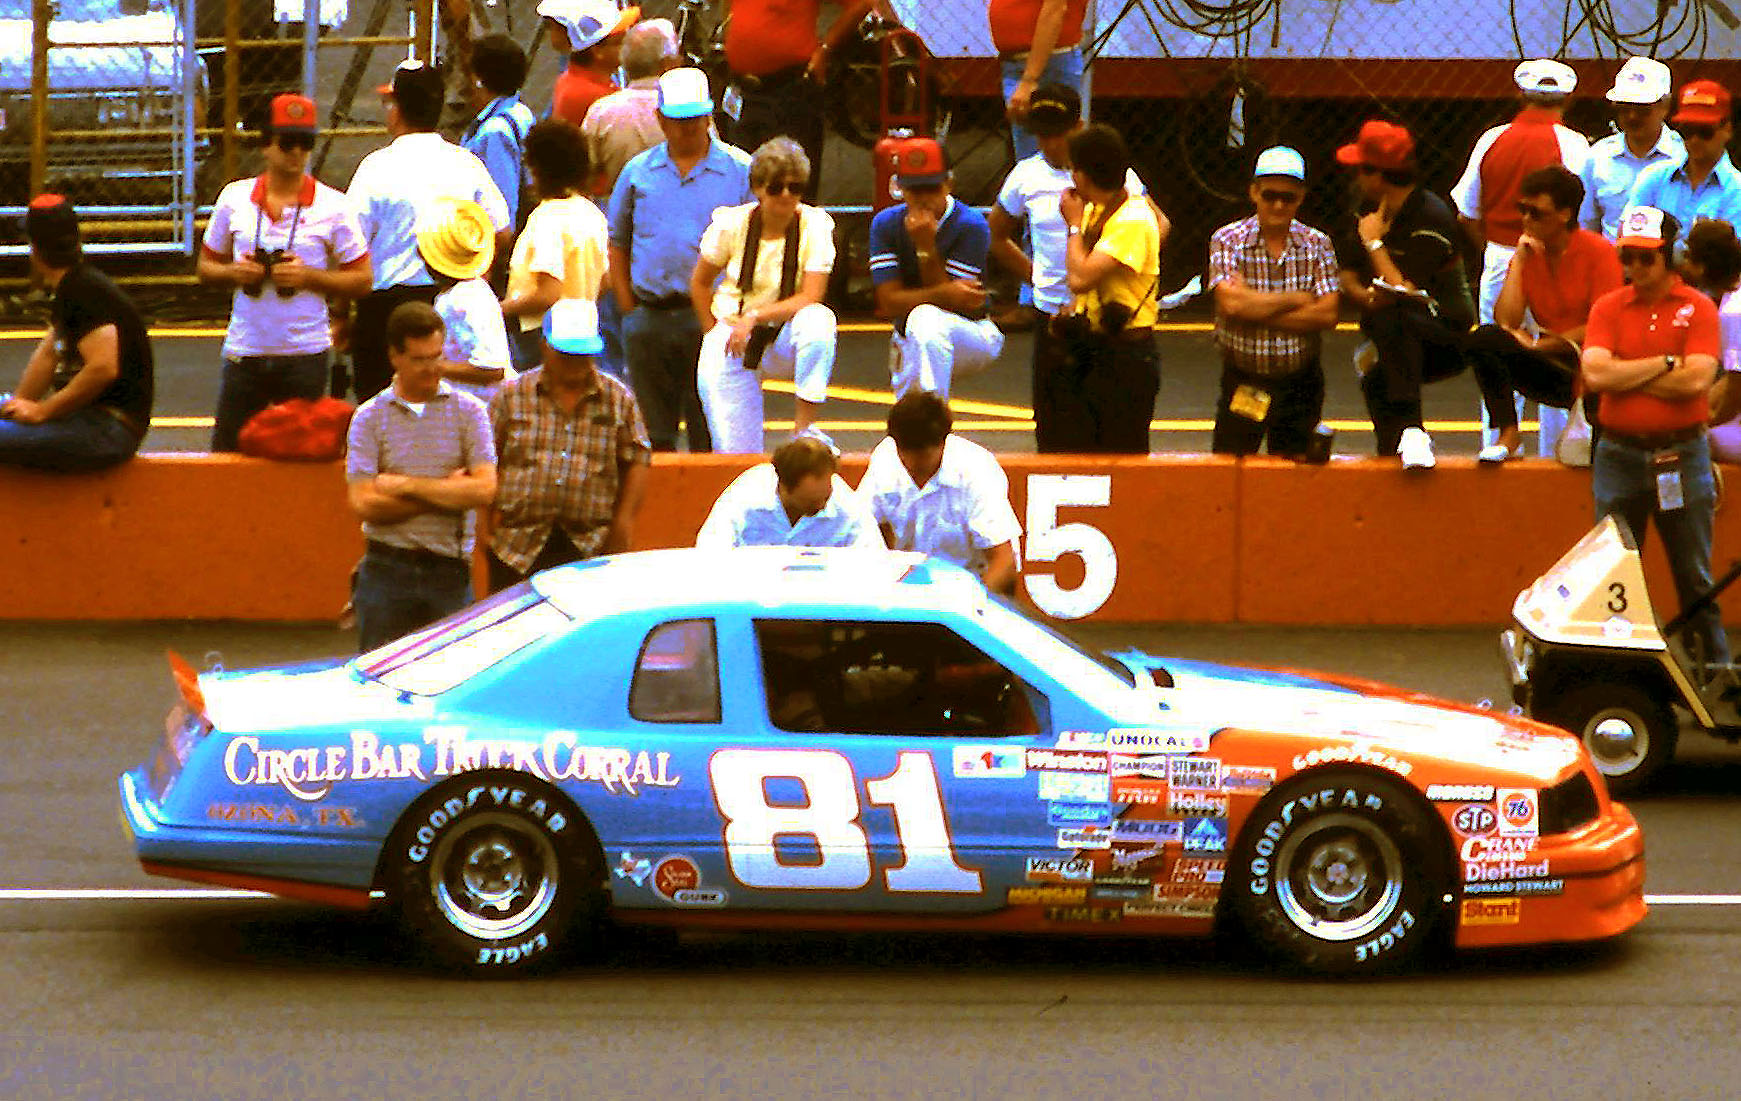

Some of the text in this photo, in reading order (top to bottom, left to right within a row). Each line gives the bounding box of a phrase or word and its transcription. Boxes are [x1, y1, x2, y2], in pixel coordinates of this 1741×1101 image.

[1024, 474, 1117, 620] 5
[1607, 582, 1628, 613] 3
[1111, 733, 1186, 747] UNOCAL
[350, 729, 430, 781] BAR
[1112, 760, 1165, 771] CHAMPION
[1172, 760, 1217, 772] STEWART
[1172, 775, 1217, 787] WARNER
[1170, 791, 1229, 817] Holley
[1508, 799, 1528, 817] 76
[408, 786, 567, 862] GOODYEAR
[709, 748, 984, 894] 81
[1458, 806, 1494, 831] STP
[1250, 788, 1382, 895] GOODYEAR
[1030, 858, 1091, 874] VICTOR
[1466, 860, 1549, 881] DieHard
[476, 932, 549, 963] EAGLE
[1354, 910, 1415, 962] EAGLE
